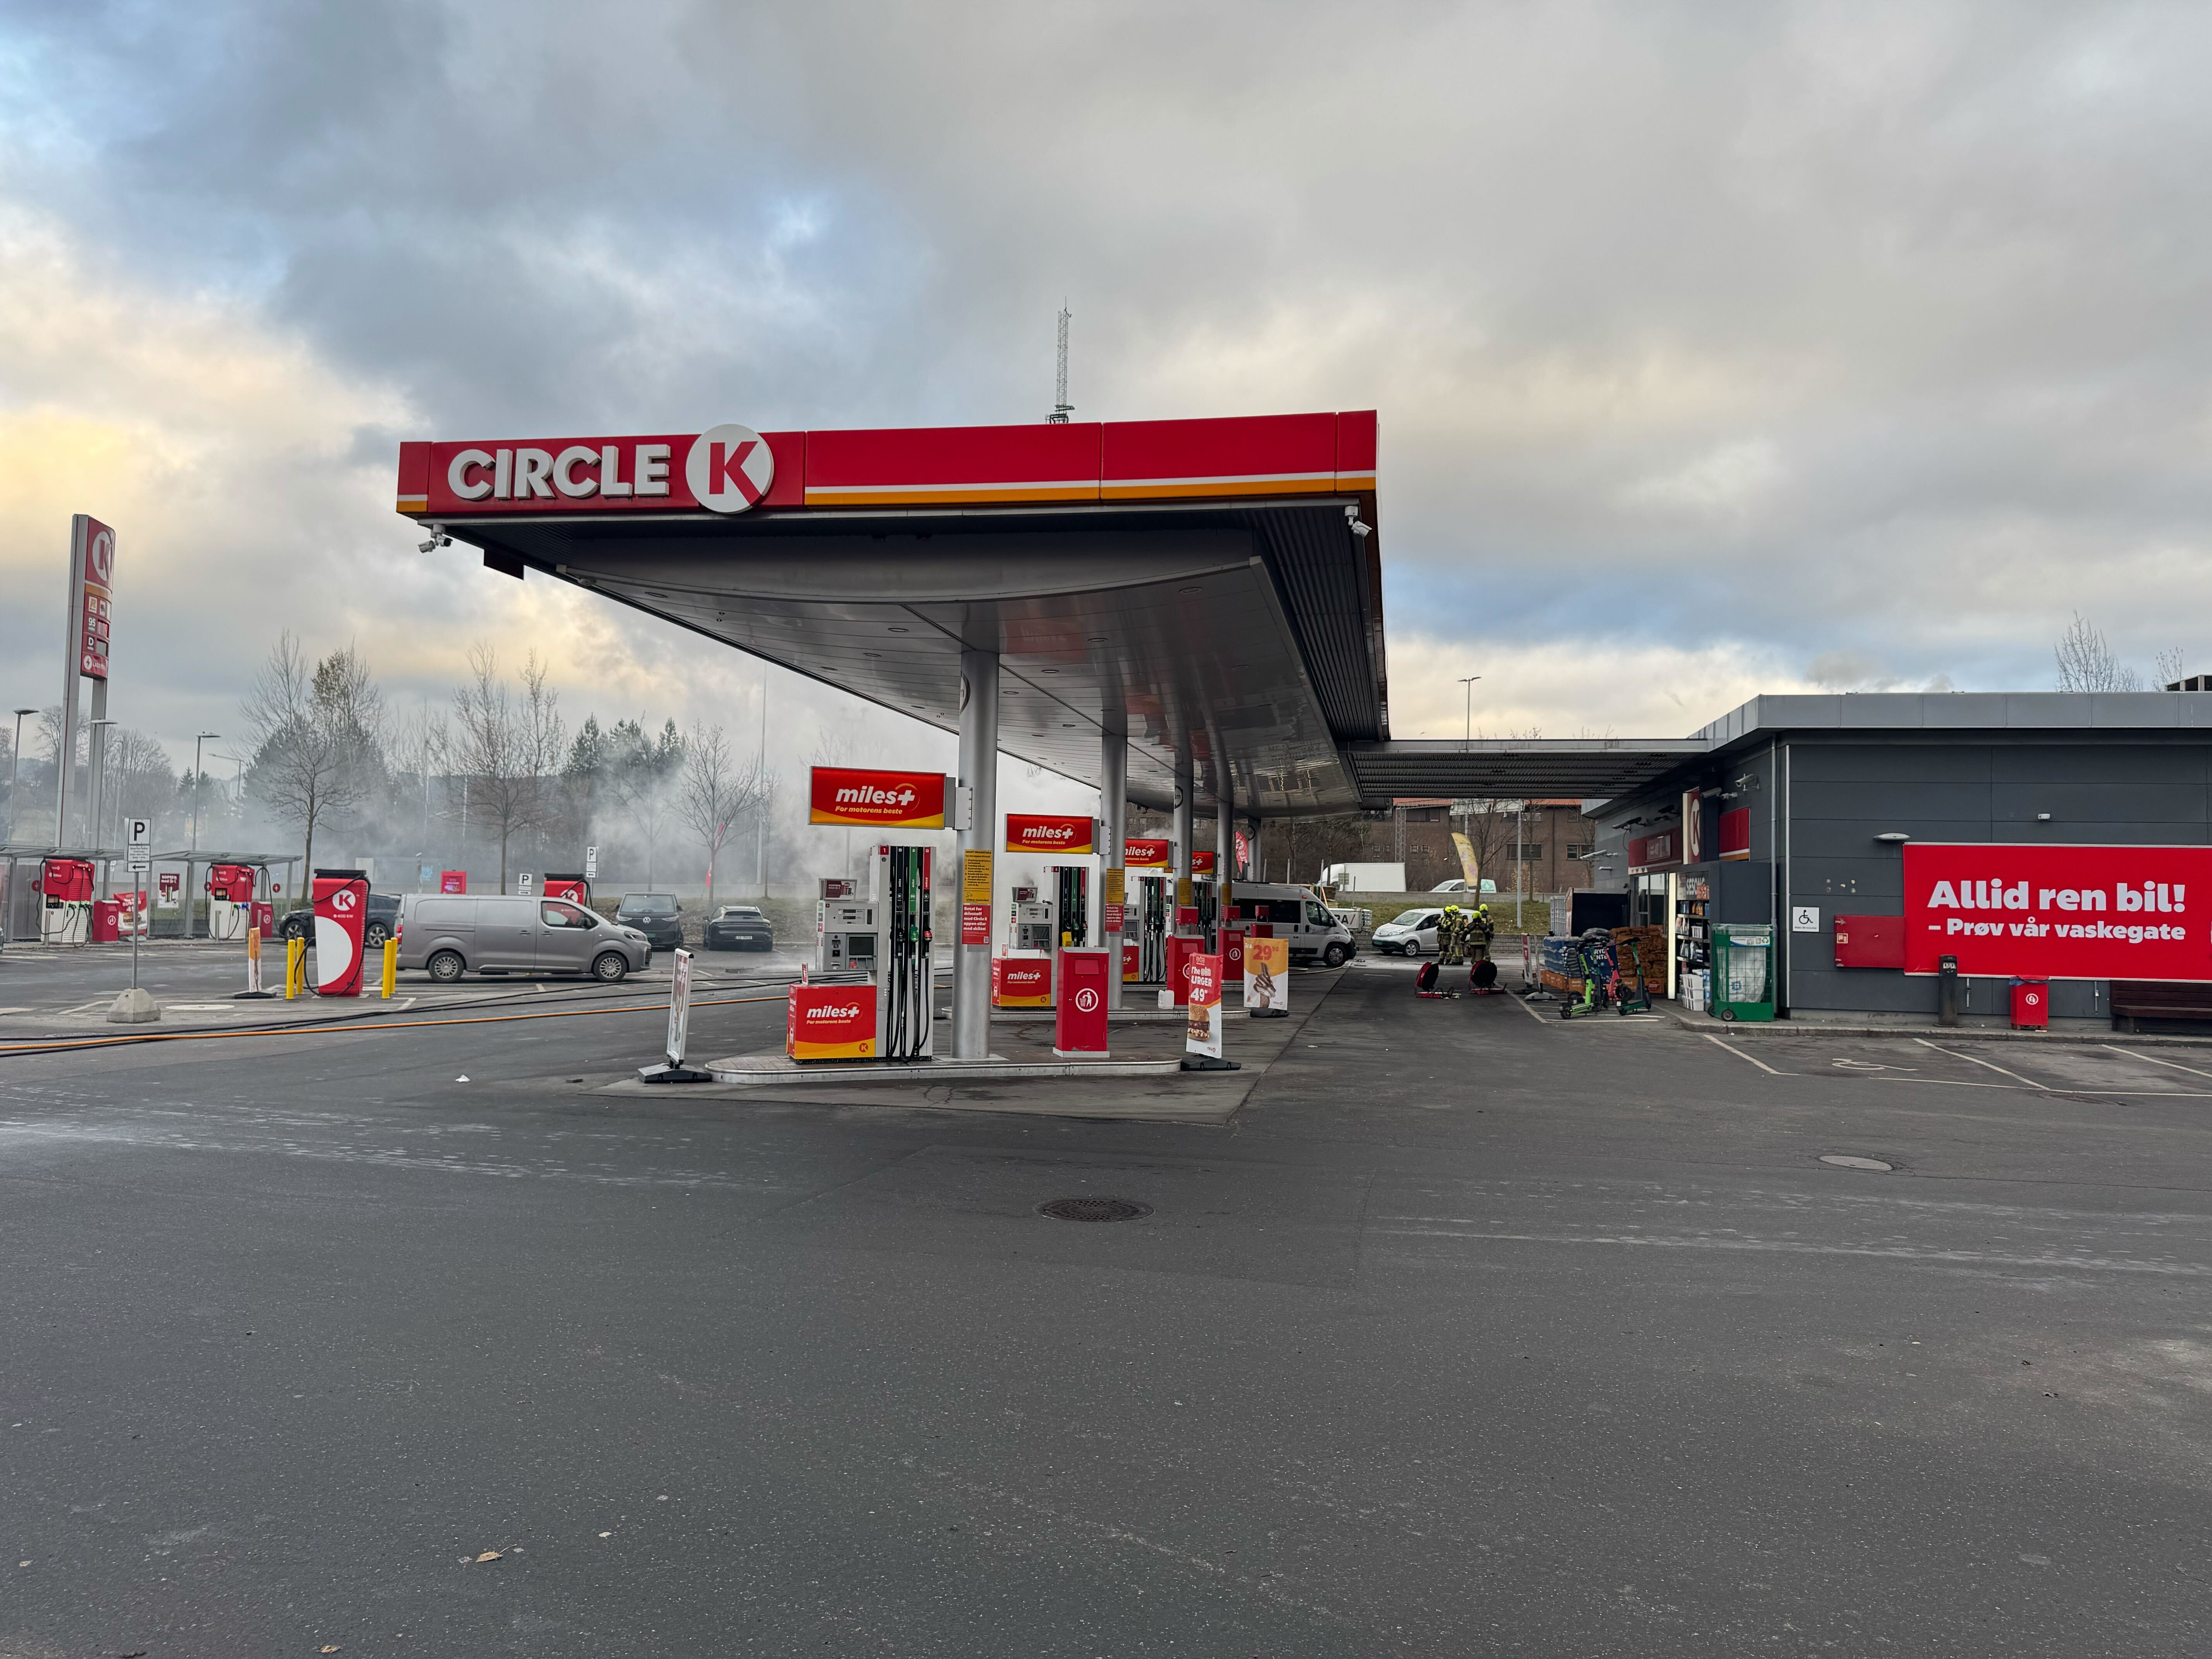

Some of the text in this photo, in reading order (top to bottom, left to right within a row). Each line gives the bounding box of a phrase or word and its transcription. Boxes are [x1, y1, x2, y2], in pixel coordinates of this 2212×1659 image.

[448, 441, 763, 506] CIRCLE K
[88, 617, 96, 627] 95
[88, 637, 94, 646] D
[836, 785, 915, 806] miles+
[134, 822, 145, 841] P
[1022, 826, 1073, 839] miles+
[589, 848, 594, 860] P
[522, 875, 529, 884] P
[1927, 878, 2185, 913] Allid ren bil!
[1947, 918, 2004, 936] Prøv
[2009, 916, 2050, 937] vår
[2054, 921, 2186, 944] vaskegate
[1008, 971, 1041, 980] miles+
[1191, 975, 1212, 987] URGER
[807, 1005, 860, 1018] miles+
